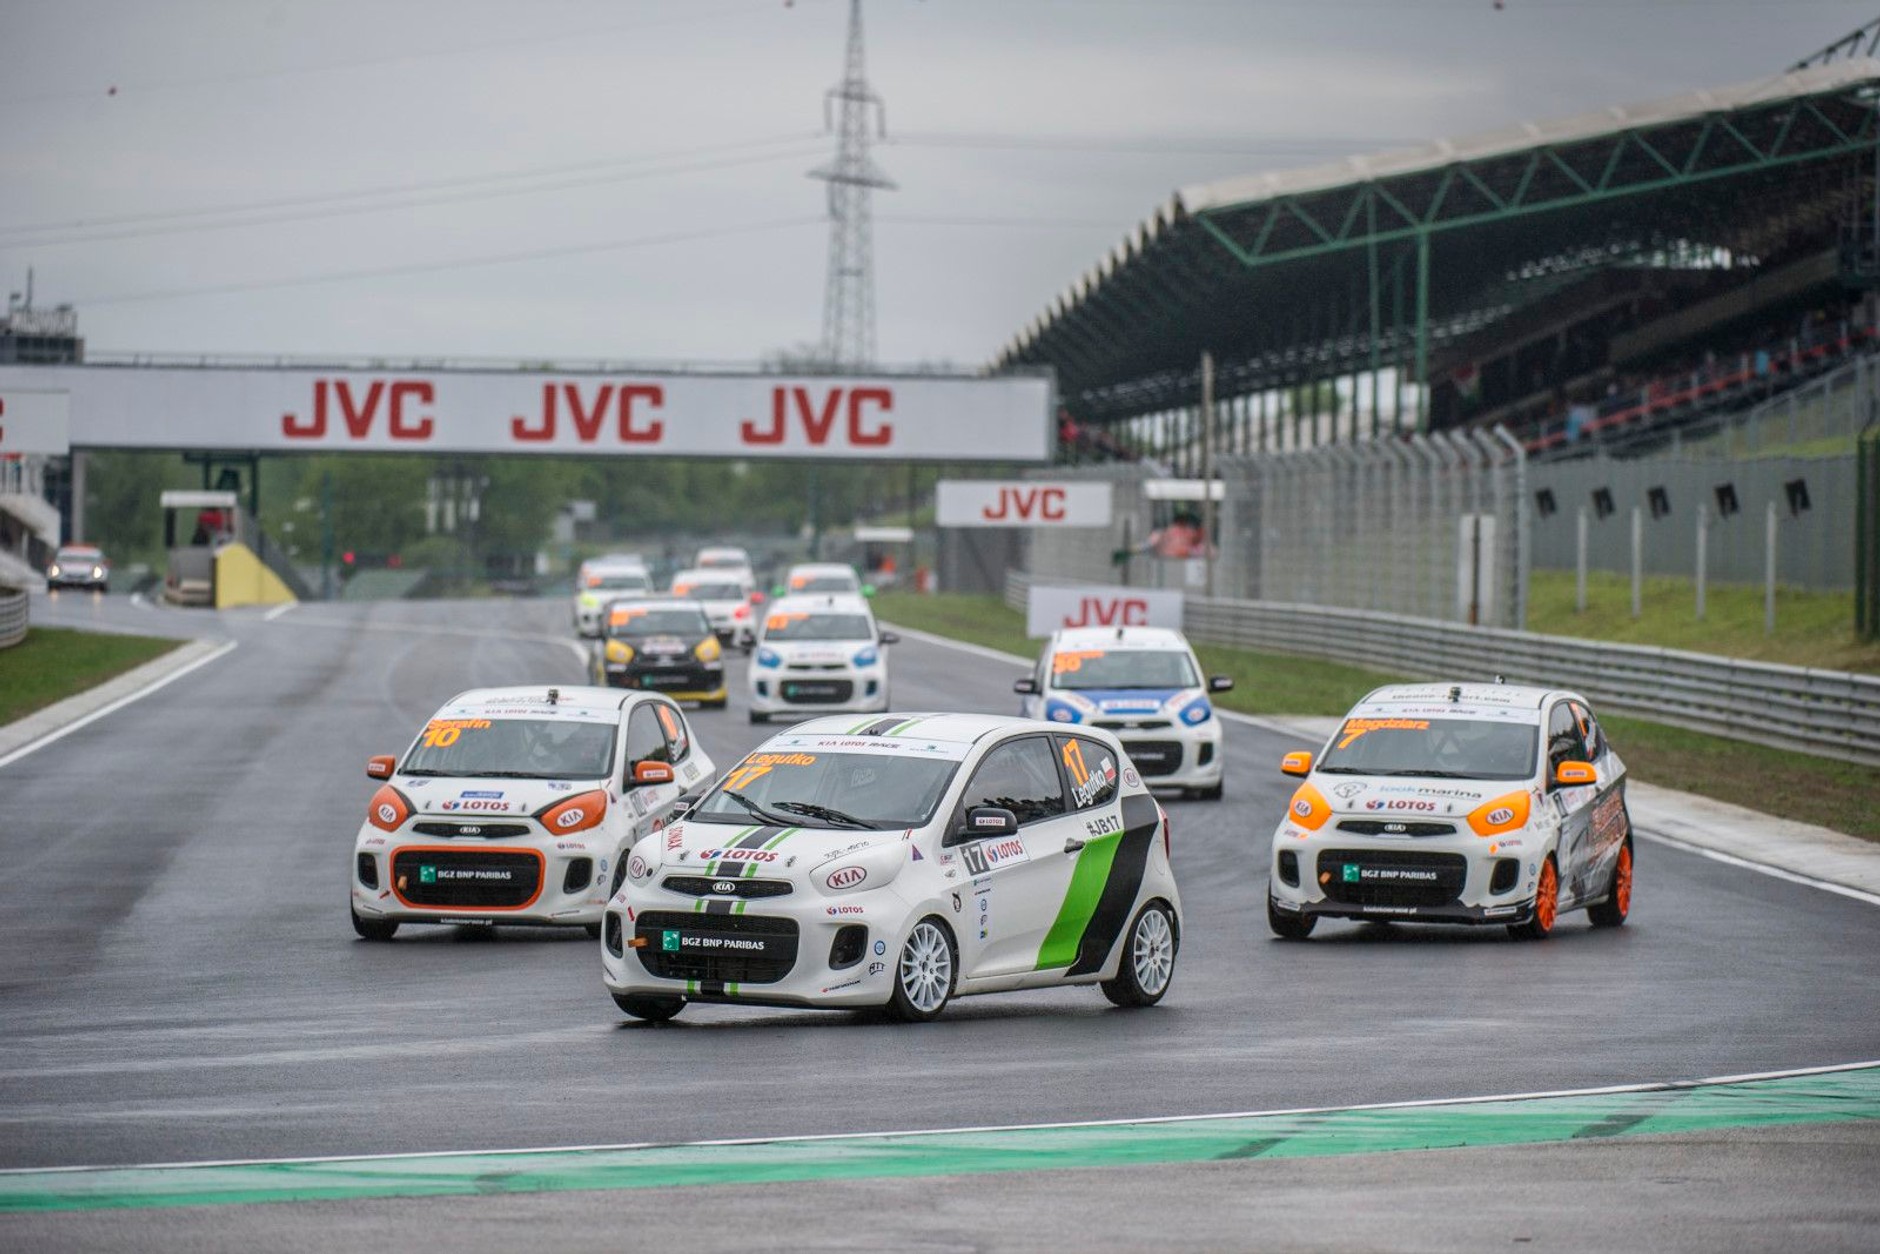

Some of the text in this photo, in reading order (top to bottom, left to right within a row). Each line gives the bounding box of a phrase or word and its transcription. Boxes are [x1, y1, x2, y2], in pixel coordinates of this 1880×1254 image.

[282, 380, 434, 440] JVC
[512, 384, 663, 443] JVC
[741, 388, 892, 447] JVC
[982, 487, 1066, 521] JVC
[1063, 597, 1149, 627] JVC
[423, 728, 461, 748] 10
[1337, 728, 1367, 749] 7
[745, 752, 817, 767] Legutko
[1062, 738, 1090, 787] 17
[722, 765, 774, 791] 17
[1071, 769, 1106, 809] Legutko
[379, 805, 394, 822] KIA
[462, 800, 509, 811] LOTOS
[1295, 801, 1309, 815] KIA
[1387, 800, 1435, 811] LOTOS
[560, 809, 583, 826] KIA
[1490, 808, 1511, 823] KIA
[1085, 815, 1121, 836] #JB17
[722, 850, 779, 862] LOTOS
[963, 846, 985, 873] 17
[996, 840, 1024, 859] LOTOS
[456, 870, 474, 879] BNP
[475, 871, 512, 880] PARIBAS
[832, 869, 862, 887] KIA
[1380, 870, 1399, 878] BNP
[1400, 871, 1437, 880] PARIBAS
[838, 906, 864, 914] LOTOS
[702, 939, 723, 948] BNP
[724, 939, 765, 950] PARIBAS
